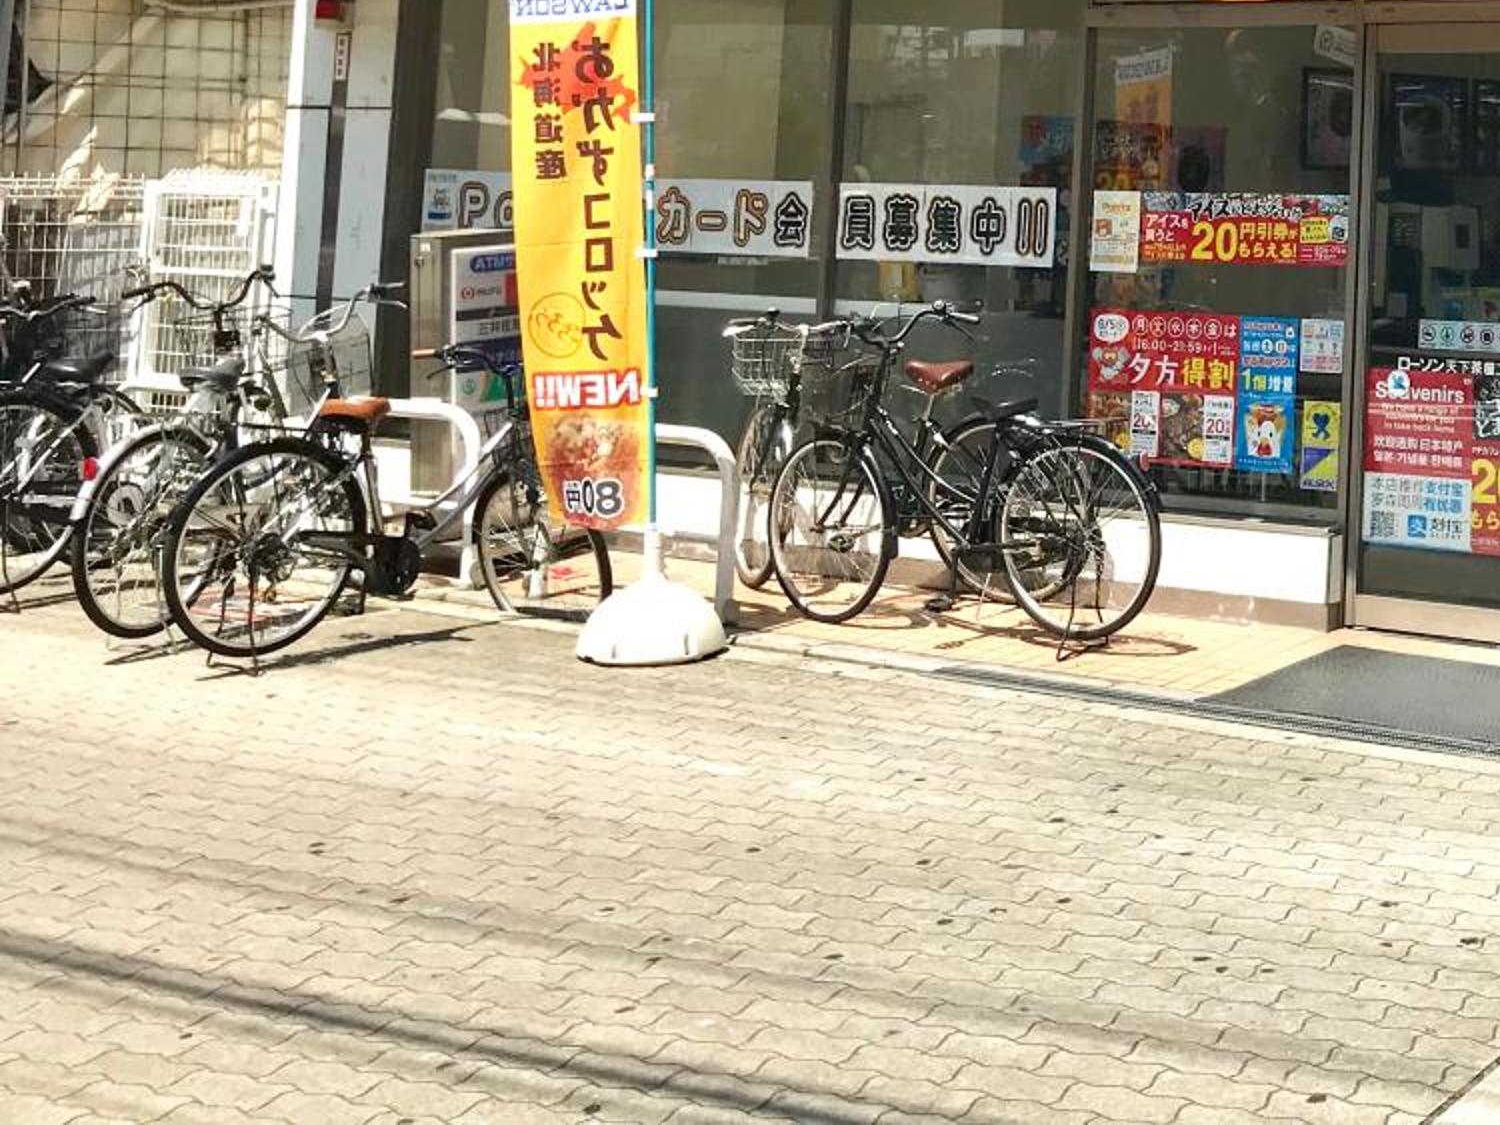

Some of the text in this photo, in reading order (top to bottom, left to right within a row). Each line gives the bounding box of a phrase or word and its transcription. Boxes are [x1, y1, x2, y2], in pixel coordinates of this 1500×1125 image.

[654, 186, 807, 249] カード会
[1190, 221, 1239, 263] 20
[1128, 352, 1235, 391] 夕方得割
[1375, 381, 1465, 404] Svenirs
[1206, 418, 1225, 434] 20
